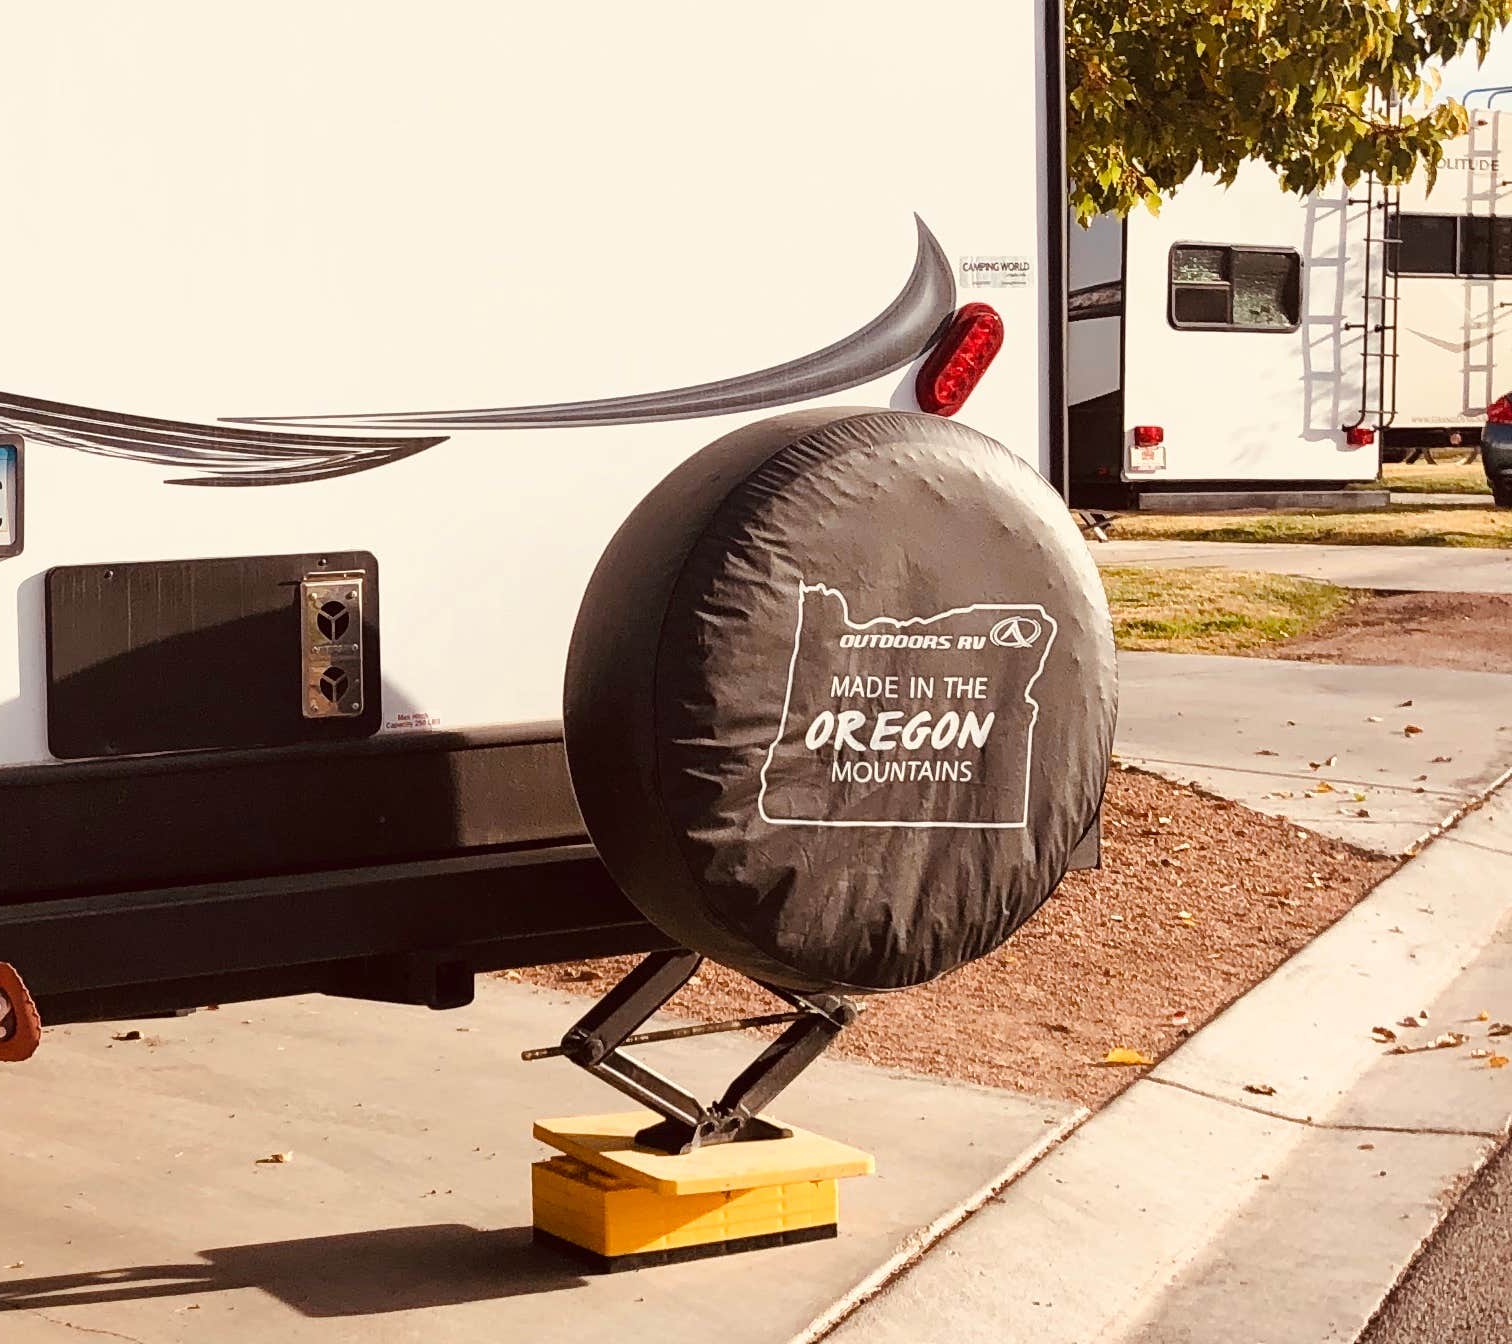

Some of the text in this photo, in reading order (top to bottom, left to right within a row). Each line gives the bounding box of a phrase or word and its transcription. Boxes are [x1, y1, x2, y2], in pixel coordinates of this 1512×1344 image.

[1435, 158, 1499, 171] OLITUDE
[962, 262, 1029, 272] CAMPING WORLD
[839, 634, 986, 650] OUTDOORS RV
[830, 675, 988, 699] MADE IN THE
[804, 710, 996, 752] OREGON
[831, 760, 973, 783] MOUNTAINS
